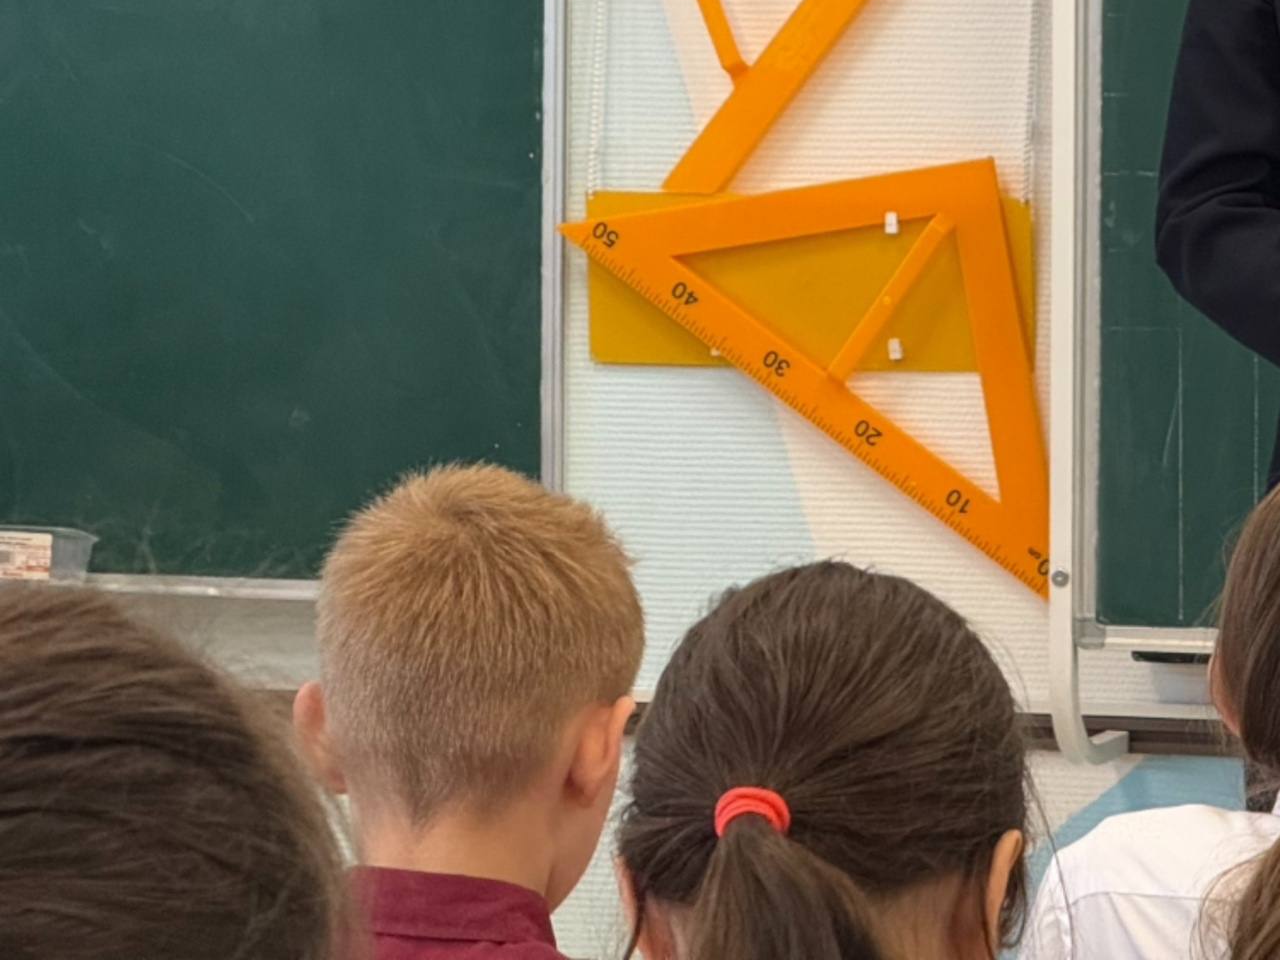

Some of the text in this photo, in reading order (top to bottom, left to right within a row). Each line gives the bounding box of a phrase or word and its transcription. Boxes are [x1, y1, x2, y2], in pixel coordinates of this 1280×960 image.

[592, 221, 619, 249] 50
[671, 281, 699, 307] 40
[762, 350, 791, 378] 30
[854, 419, 883, 448] 20
[945, 488, 972, 514] 10
